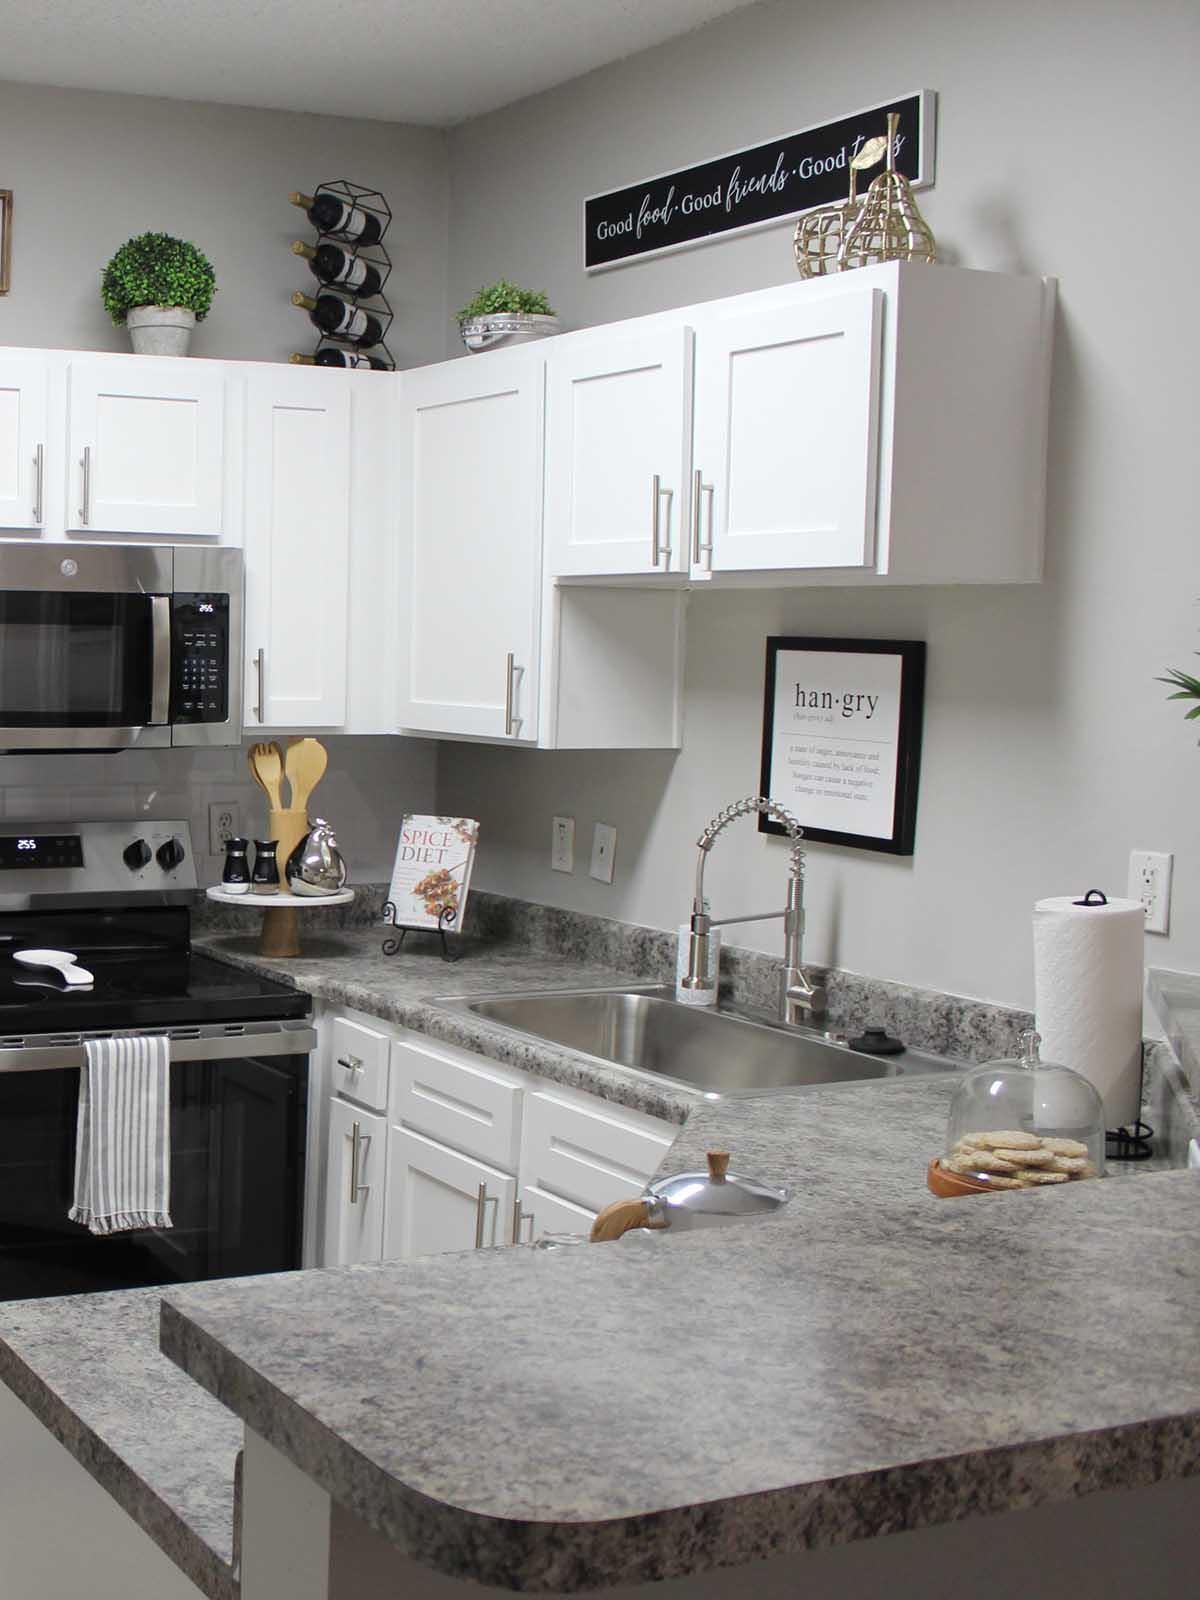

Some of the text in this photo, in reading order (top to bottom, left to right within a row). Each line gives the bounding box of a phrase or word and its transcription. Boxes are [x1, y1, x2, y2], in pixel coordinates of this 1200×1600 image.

[596, 212, 633, 240] Good
[681, 184, 722, 215] Good
[725, 151, 789, 213] friends
[799, 147, 846, 179] Good
[402, 829, 455, 848] SPICE
[401, 846, 449, 864] DIET
